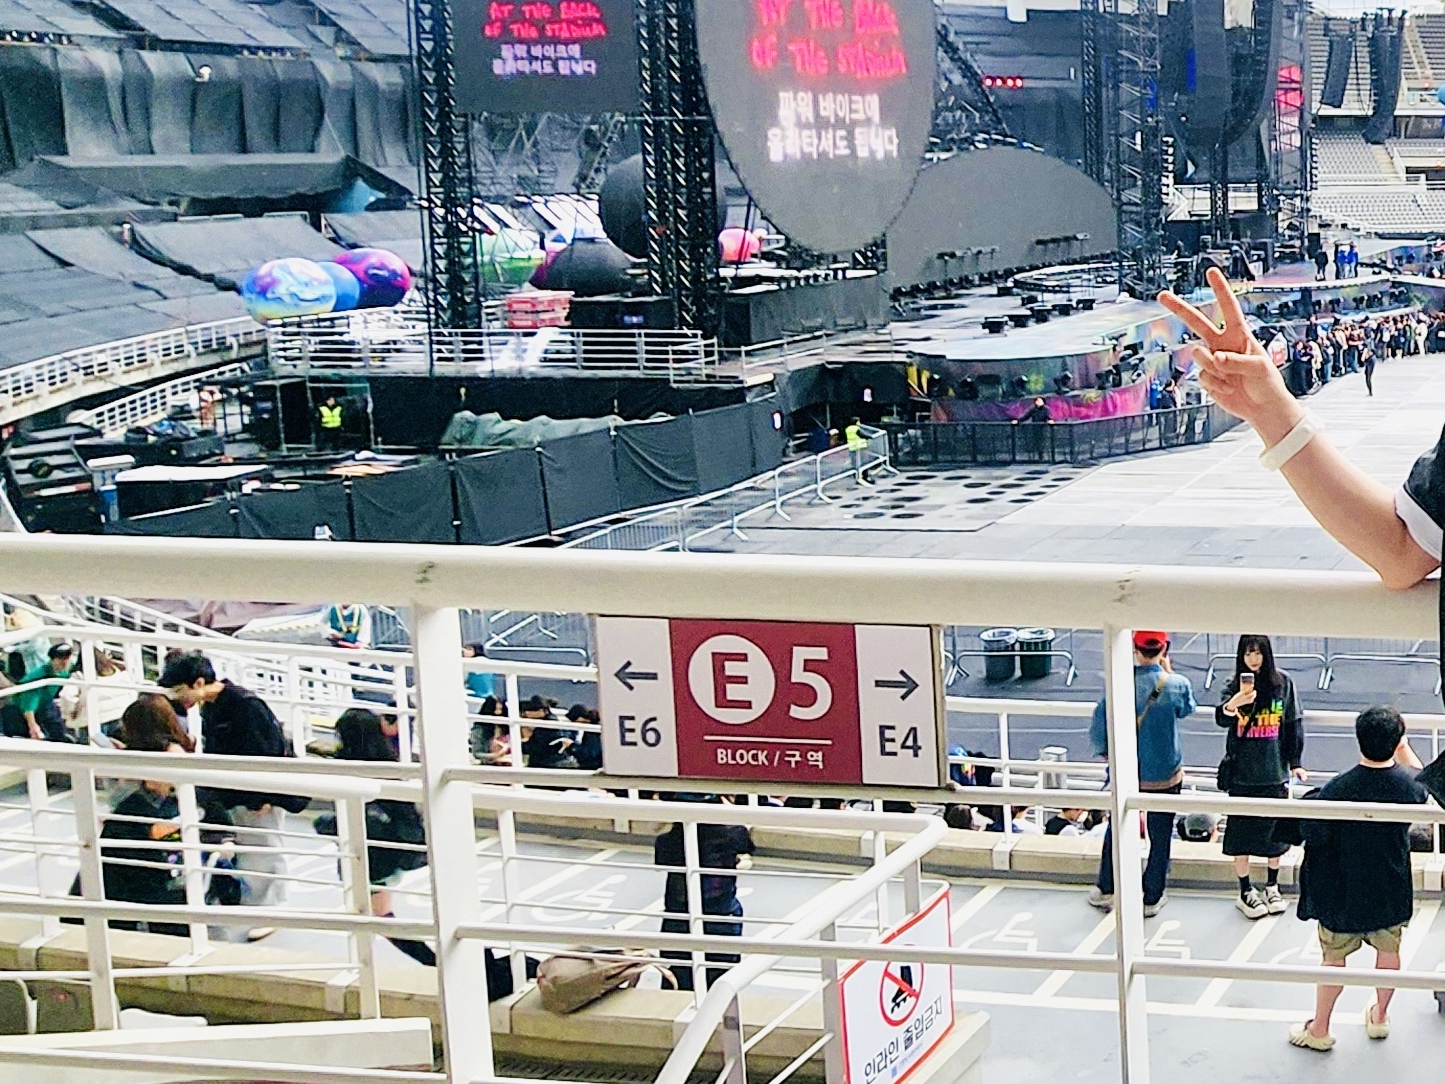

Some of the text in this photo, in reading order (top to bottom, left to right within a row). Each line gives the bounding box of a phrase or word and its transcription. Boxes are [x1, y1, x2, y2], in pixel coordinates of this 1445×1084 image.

[788, 646, 833, 721] 5
[618, 715, 661, 748] E6
[879, 724, 922, 758] E4
[717, 749, 769, 766] BLOCK
[864, 1037, 899, 1084] 인라인
